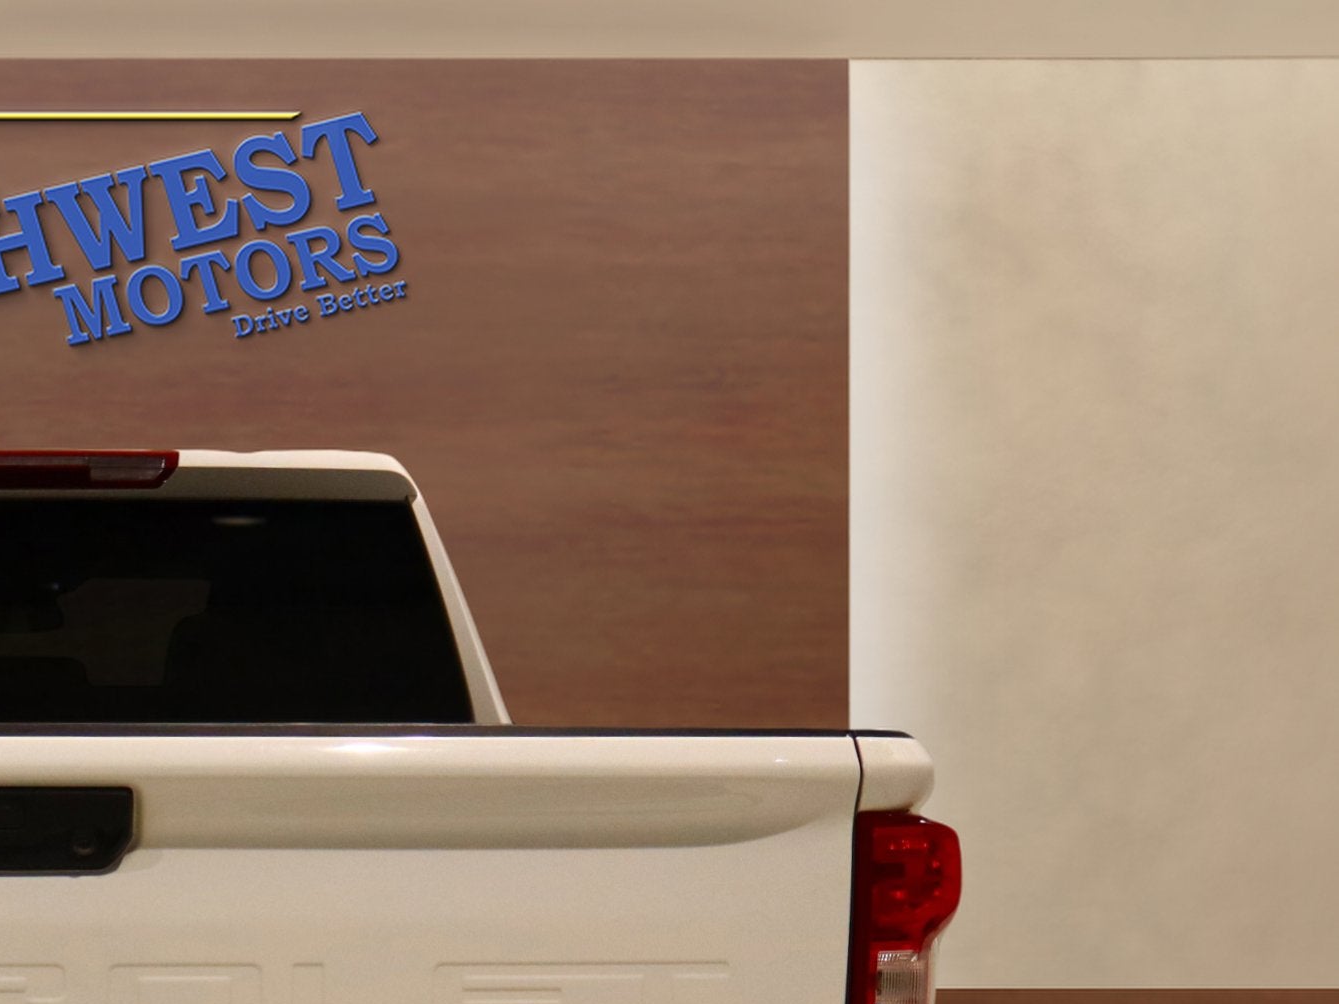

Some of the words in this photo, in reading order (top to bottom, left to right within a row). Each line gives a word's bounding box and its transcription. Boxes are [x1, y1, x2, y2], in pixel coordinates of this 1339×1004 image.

[53, 213, 401, 346] MOTORS
[231, 305, 310, 338] Drive
[316, 279, 407, 317] Better
